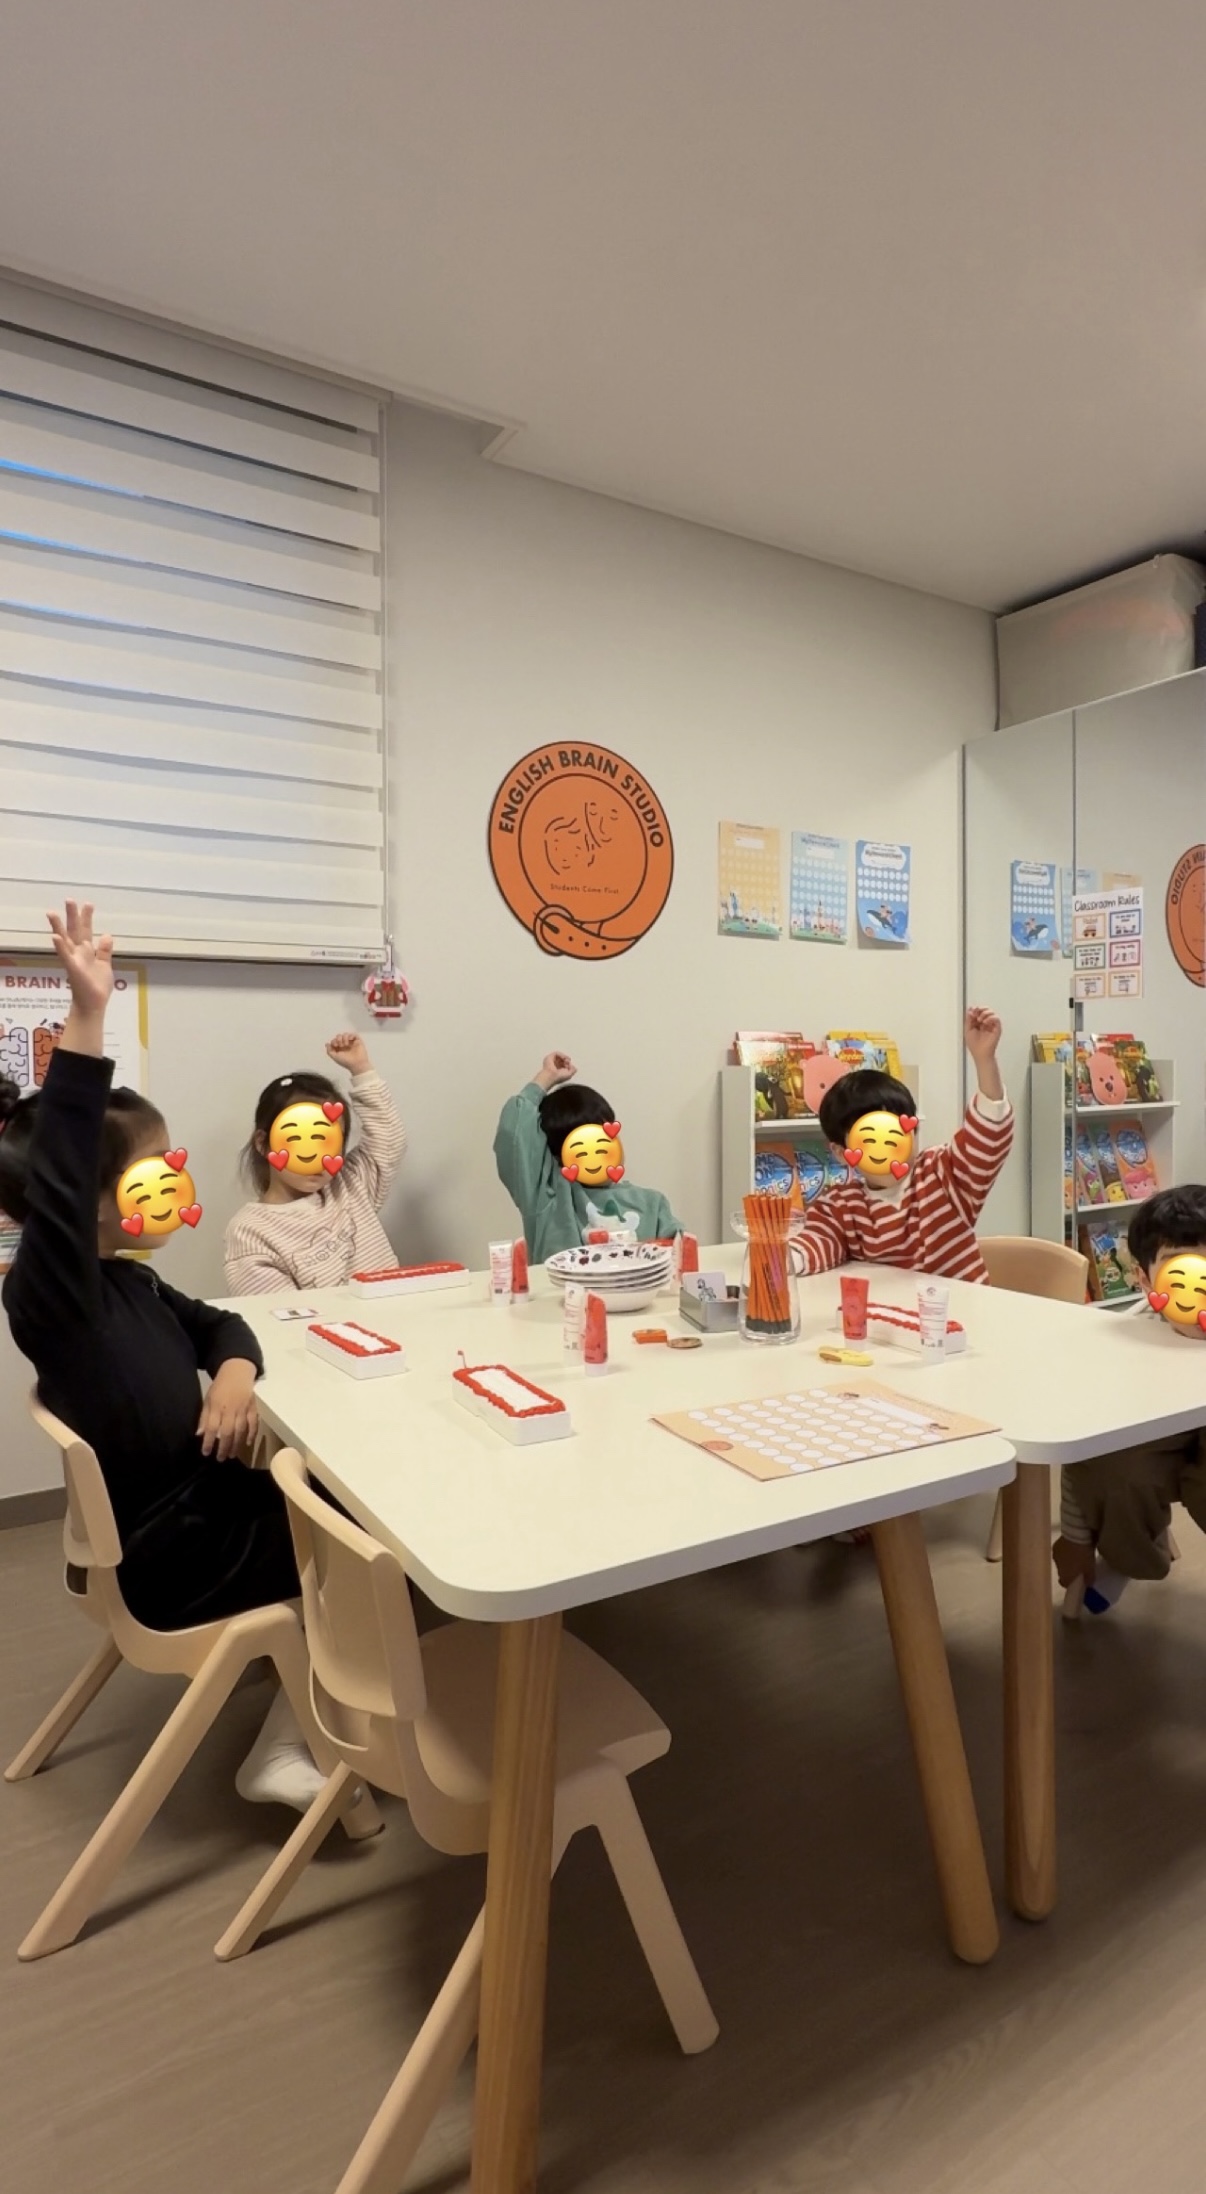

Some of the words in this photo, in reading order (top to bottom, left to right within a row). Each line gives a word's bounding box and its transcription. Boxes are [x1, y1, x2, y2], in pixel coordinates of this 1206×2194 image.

[498, 755, 555, 834] ENGLISH
[558, 750, 619, 779] BRAIN
[620, 775, 665, 848] STUDIO
[550, 883, 580, 892] Students
[582, 885, 601, 893] Come
[1074, 899, 1116, 912] Classroom
[1117, 894, 1140, 907] Rules
[5, 975, 61, 989] BRAIN
